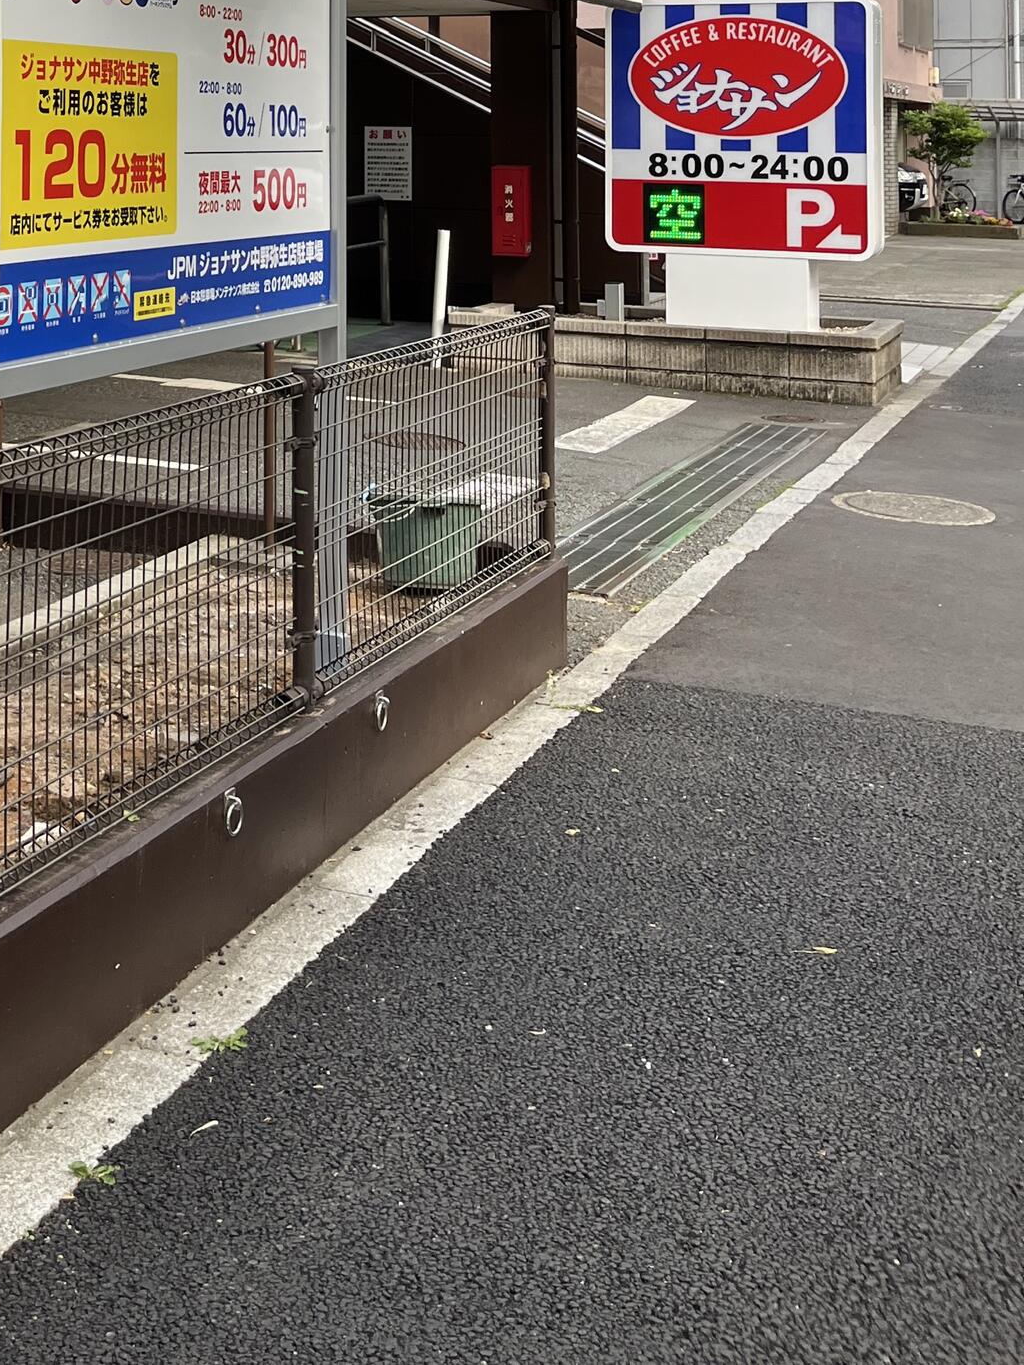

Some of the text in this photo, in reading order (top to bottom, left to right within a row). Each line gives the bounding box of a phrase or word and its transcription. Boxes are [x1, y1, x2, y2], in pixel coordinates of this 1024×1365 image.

[643, 21, 835, 69] COFFEE & RESTAURANT
[20, 53, 160, 87] ジョナサン中野弥生店を
[38, 88, 148, 117] ご利用のお客様は
[649, 61, 823, 131] ジョナサン
[198, 170, 241, 196] 夜間最大
[649, 188, 703, 240] 空
[785, 187, 837, 248] P
[167, 255, 197, 280] JPM
